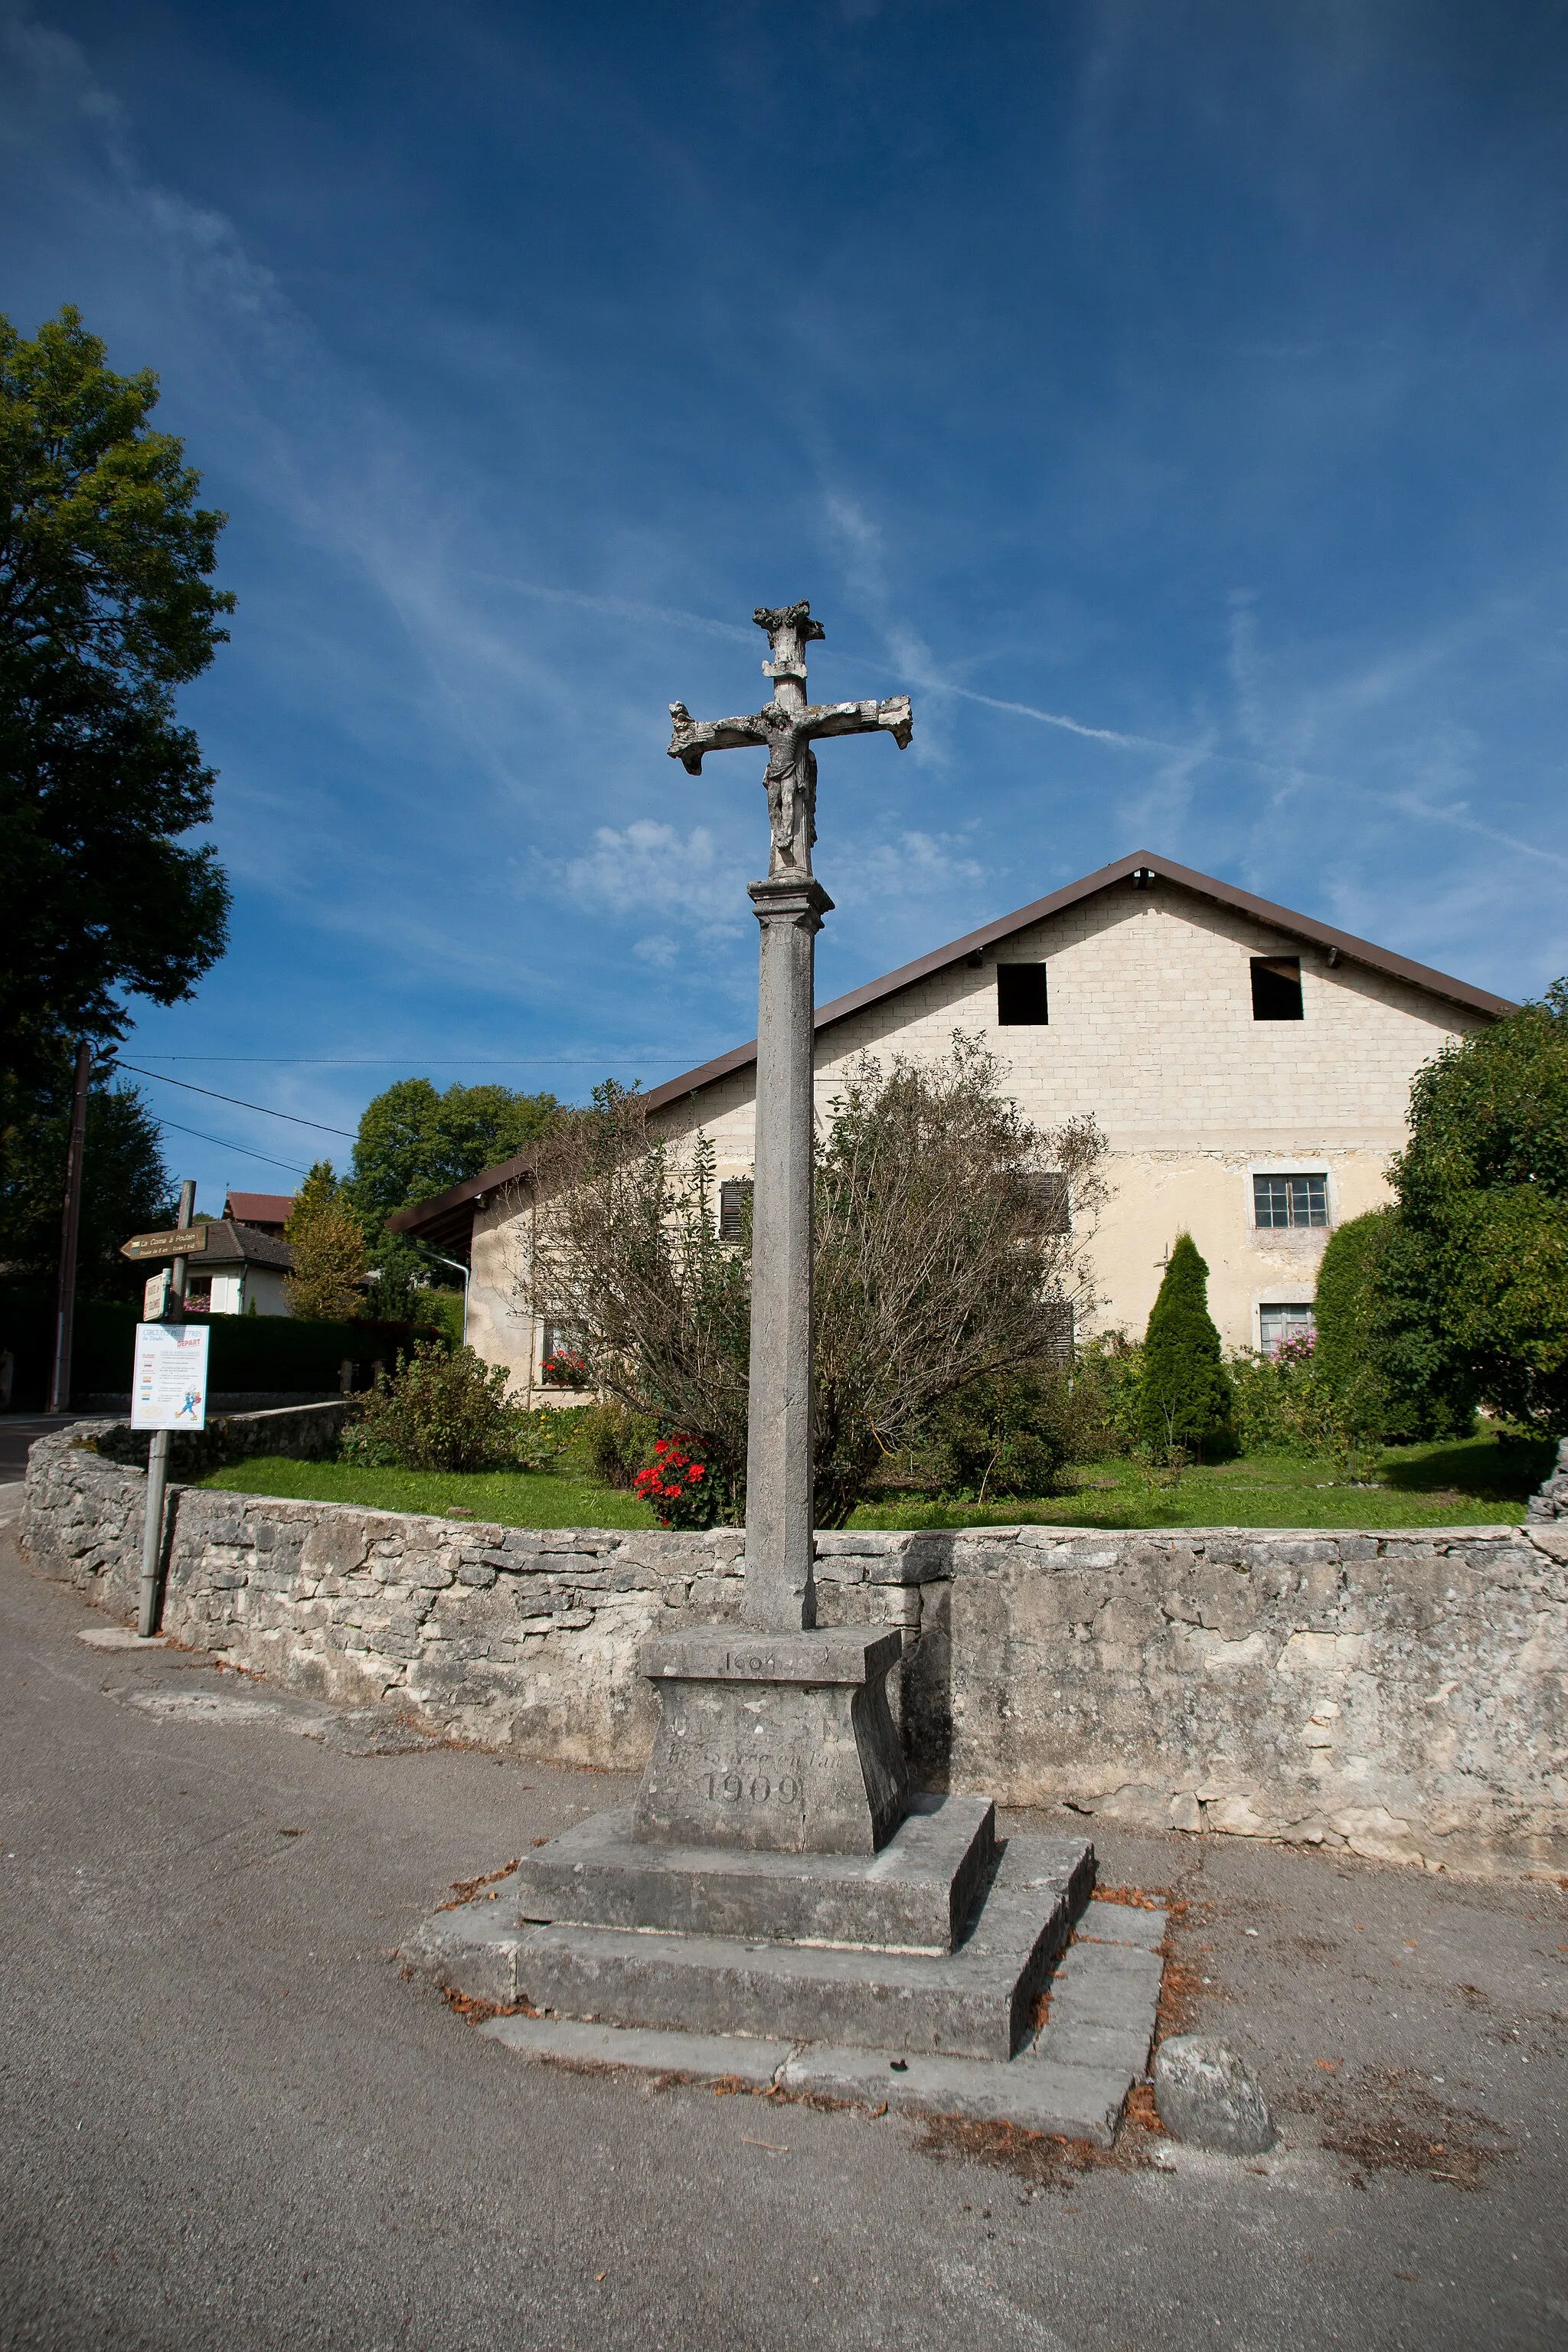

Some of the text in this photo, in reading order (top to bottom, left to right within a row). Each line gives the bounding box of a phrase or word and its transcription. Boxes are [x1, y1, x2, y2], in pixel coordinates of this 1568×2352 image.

[175, 1233, 195, 1242] Poulain
[143, 1328, 170, 1337] CIRCUITS
[703, 1770, 799, 1804] 1909
